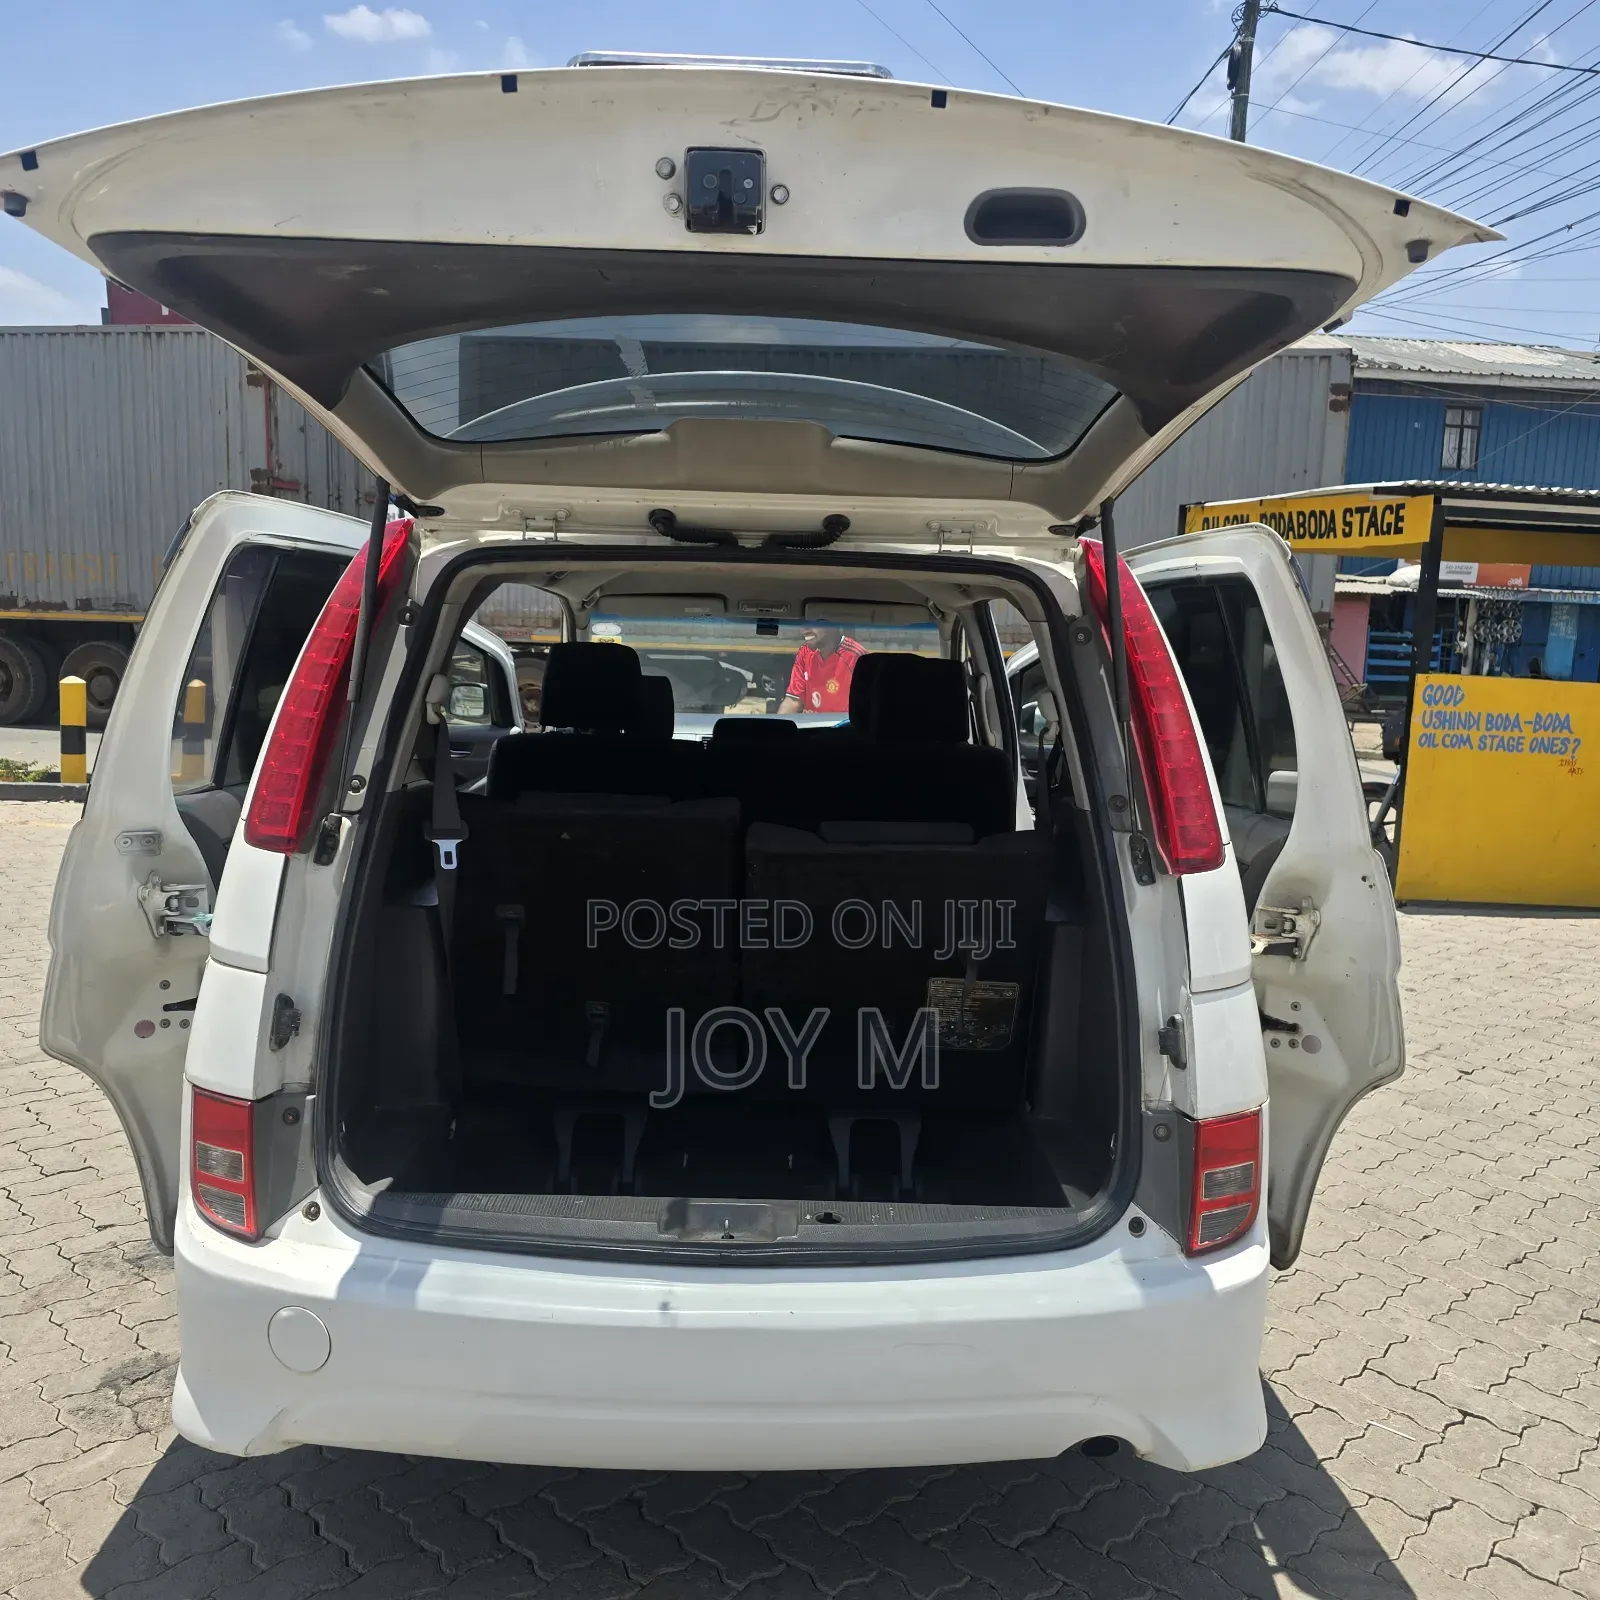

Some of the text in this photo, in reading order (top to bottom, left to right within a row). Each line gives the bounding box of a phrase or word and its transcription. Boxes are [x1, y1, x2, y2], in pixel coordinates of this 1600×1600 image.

[1342, 502, 1406, 538] STAGE
[1422, 683, 1465, 707] GOOD
[1421, 709, 1481, 732] USHINDI
[1418, 732, 1439, 748] OIL
[1441, 733, 1473, 750] COM
[1477, 734, 1526, 753] STAGE
